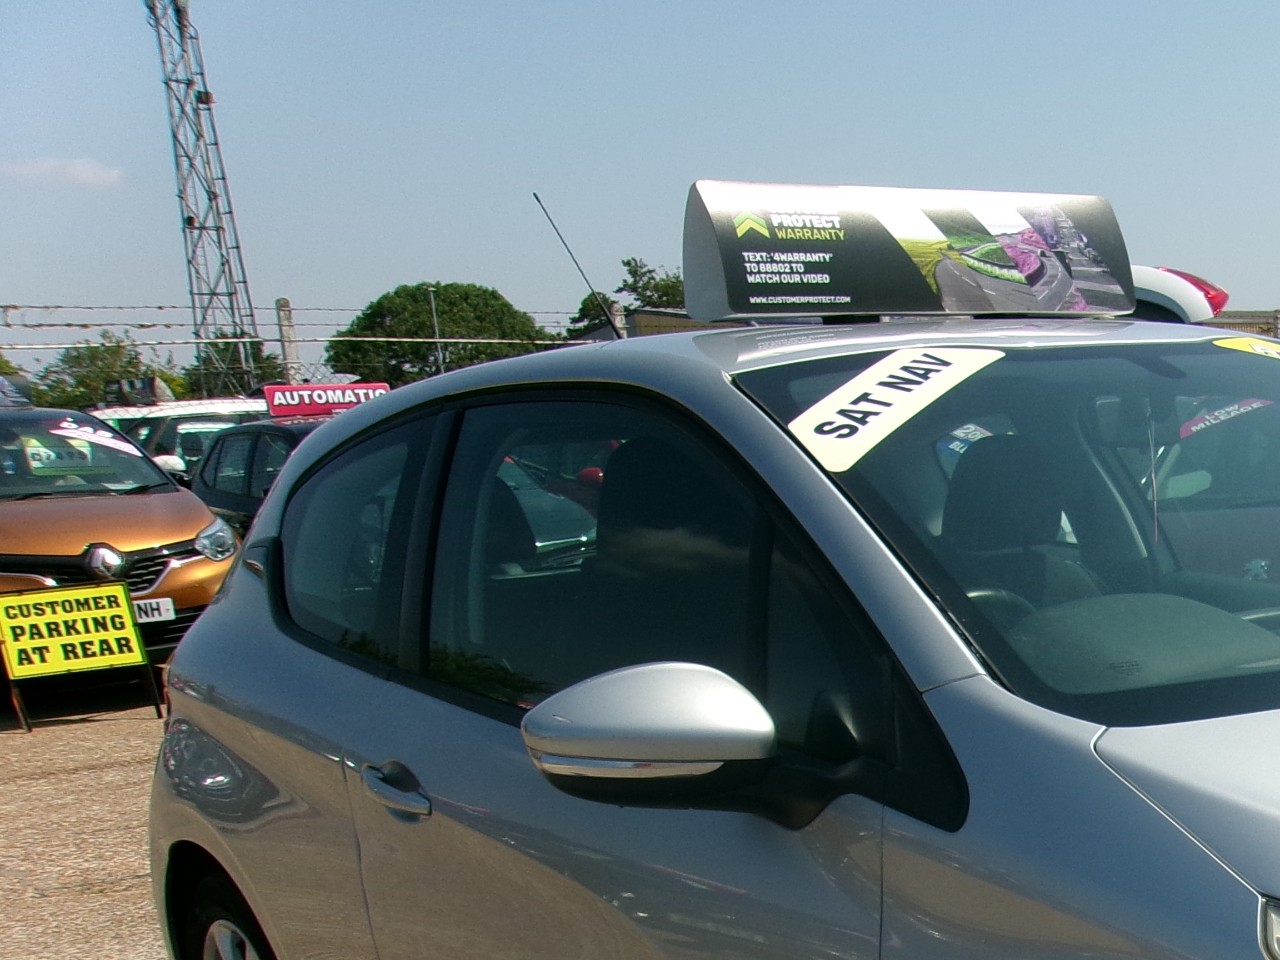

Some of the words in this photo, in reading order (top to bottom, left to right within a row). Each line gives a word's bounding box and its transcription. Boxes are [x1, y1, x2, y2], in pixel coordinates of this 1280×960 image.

[770, 213, 841, 229] PROTECT
[775, 228, 845, 240] WARRANTY
[742, 252, 771, 262] TEXT:
[744, 263, 758, 272] TO
[760, 263, 791, 272] 88802
[792, 264, 804, 272] TO
[746, 274, 780, 284] WATCH
[781, 274, 801, 284] OUR
[802, 275, 830, 284] VIDEO
[749, 296, 851, 304] WWW.CUSTOMERPROTECT.COM
[813, 391, 894, 439] SAT
[875, 353, 954, 393] NAV
[1190, 401, 1265, 433] MILEAGE
[1204, 404, 1239, 420] LOW
[4, 594, 122, 620] CUSTOMER
[9, 614, 127, 642] PARKING
[17, 645, 51, 667] AT
[60, 636, 135, 661] REAR
